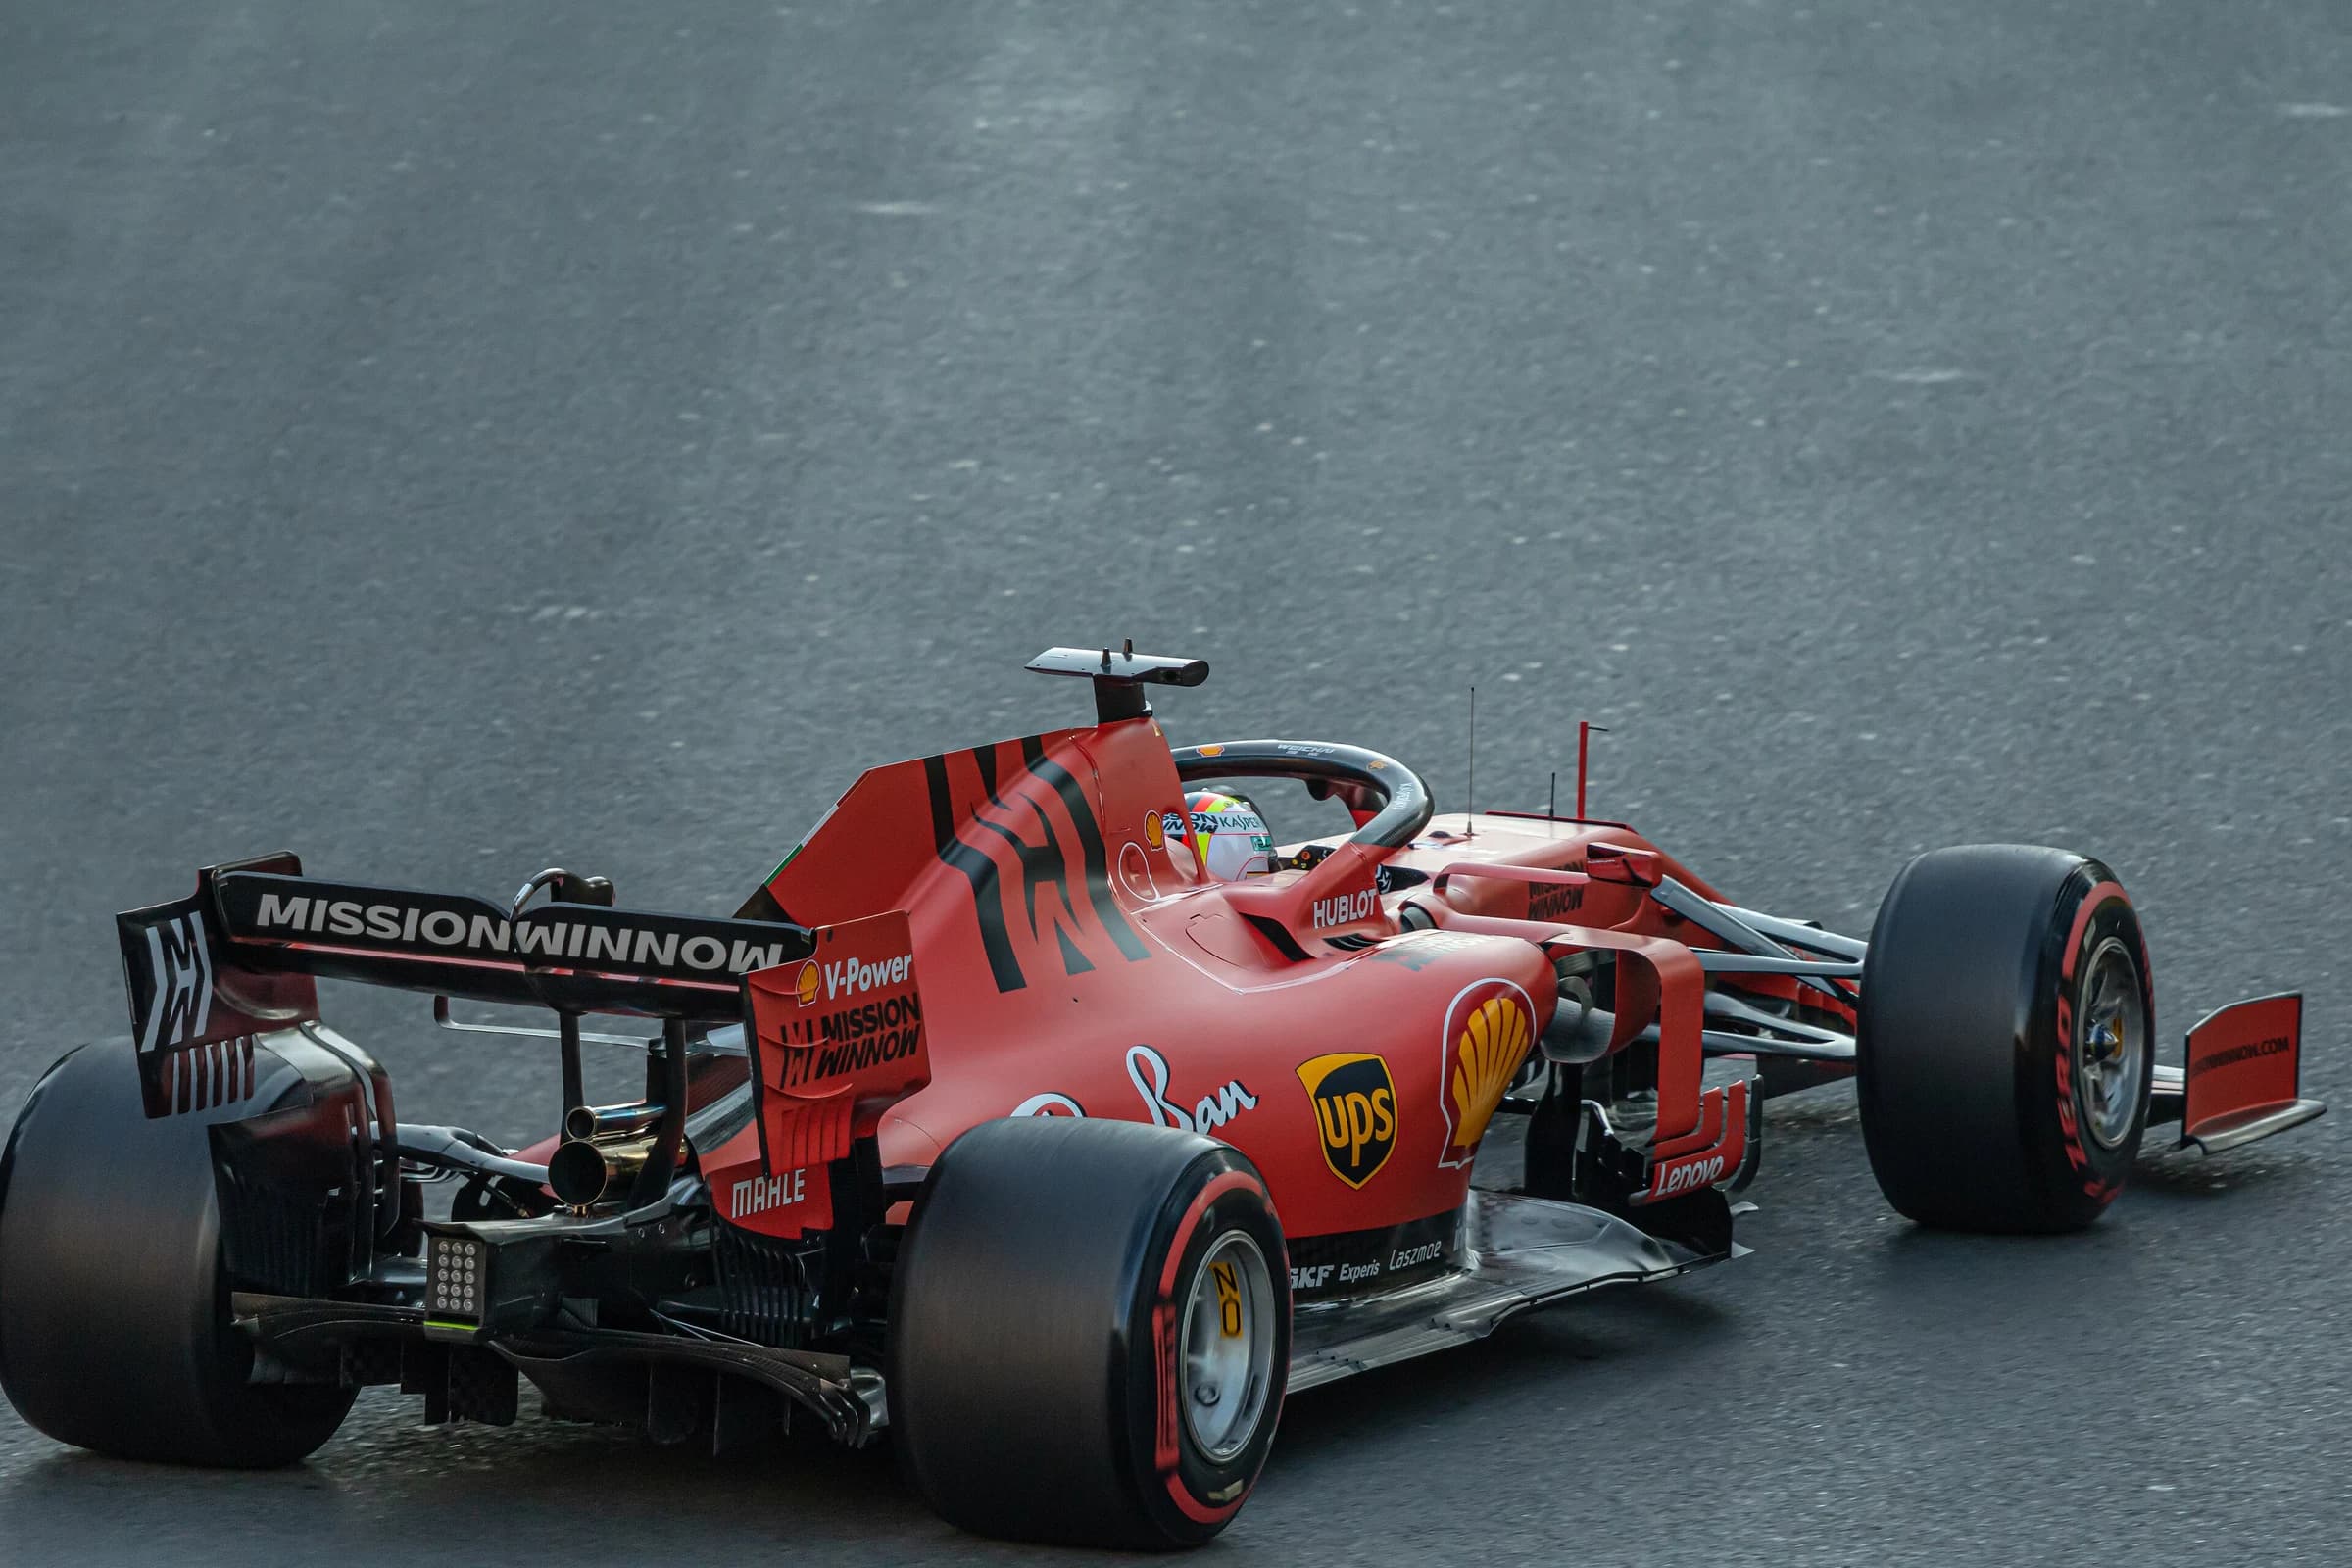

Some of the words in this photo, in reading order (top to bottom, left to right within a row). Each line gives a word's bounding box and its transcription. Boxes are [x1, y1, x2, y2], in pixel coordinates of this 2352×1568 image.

[1218, 815, 1260, 830] KASPE
[1313, 888, 1377, 929] HUBLOT
[257, 893, 511, 951] MISSION
[515, 921, 784, 972] WINNOW
[824, 954, 912, 1000] V-Power
[820, 992, 921, 1046] MISSION
[814, 1023, 921, 1079] WINNOW
[731, 1168, 806, 1218] MAHLE
[1655, 1155, 1724, 1196] Lenovo
[1339, 1259, 1380, 1283] Experis
